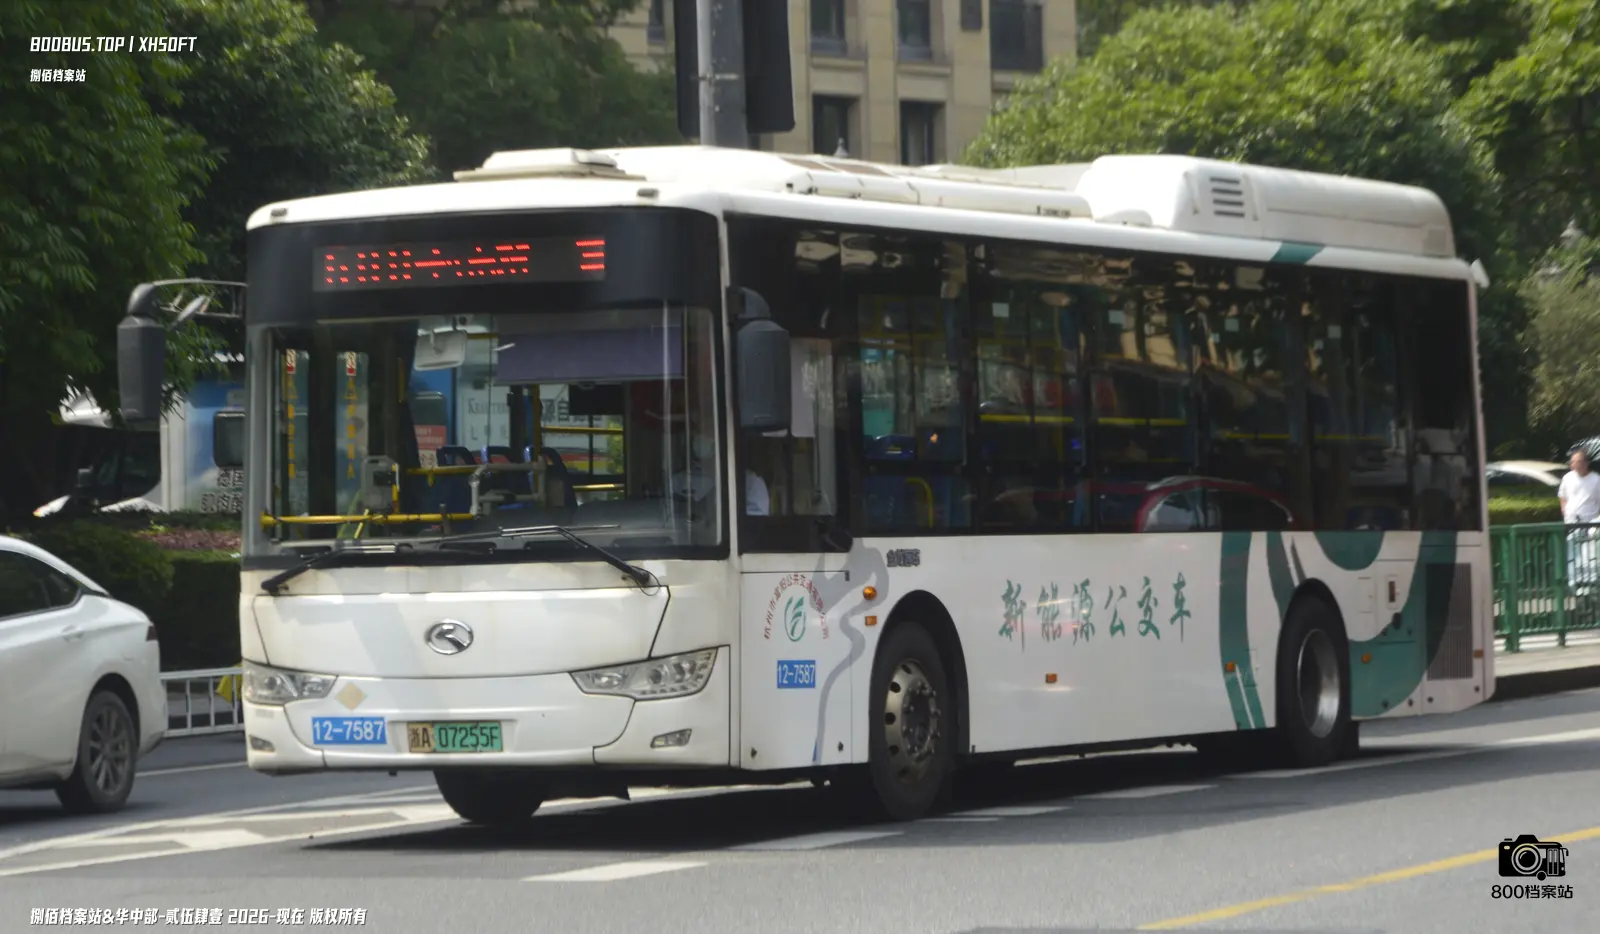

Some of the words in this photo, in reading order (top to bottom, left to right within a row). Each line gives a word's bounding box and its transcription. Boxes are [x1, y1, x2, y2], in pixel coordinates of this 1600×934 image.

[998, 571, 1192, 653] 新能源公交车
[777, 663, 816, 685] 12-7587
[313, 719, 385, 742] 12-7587
